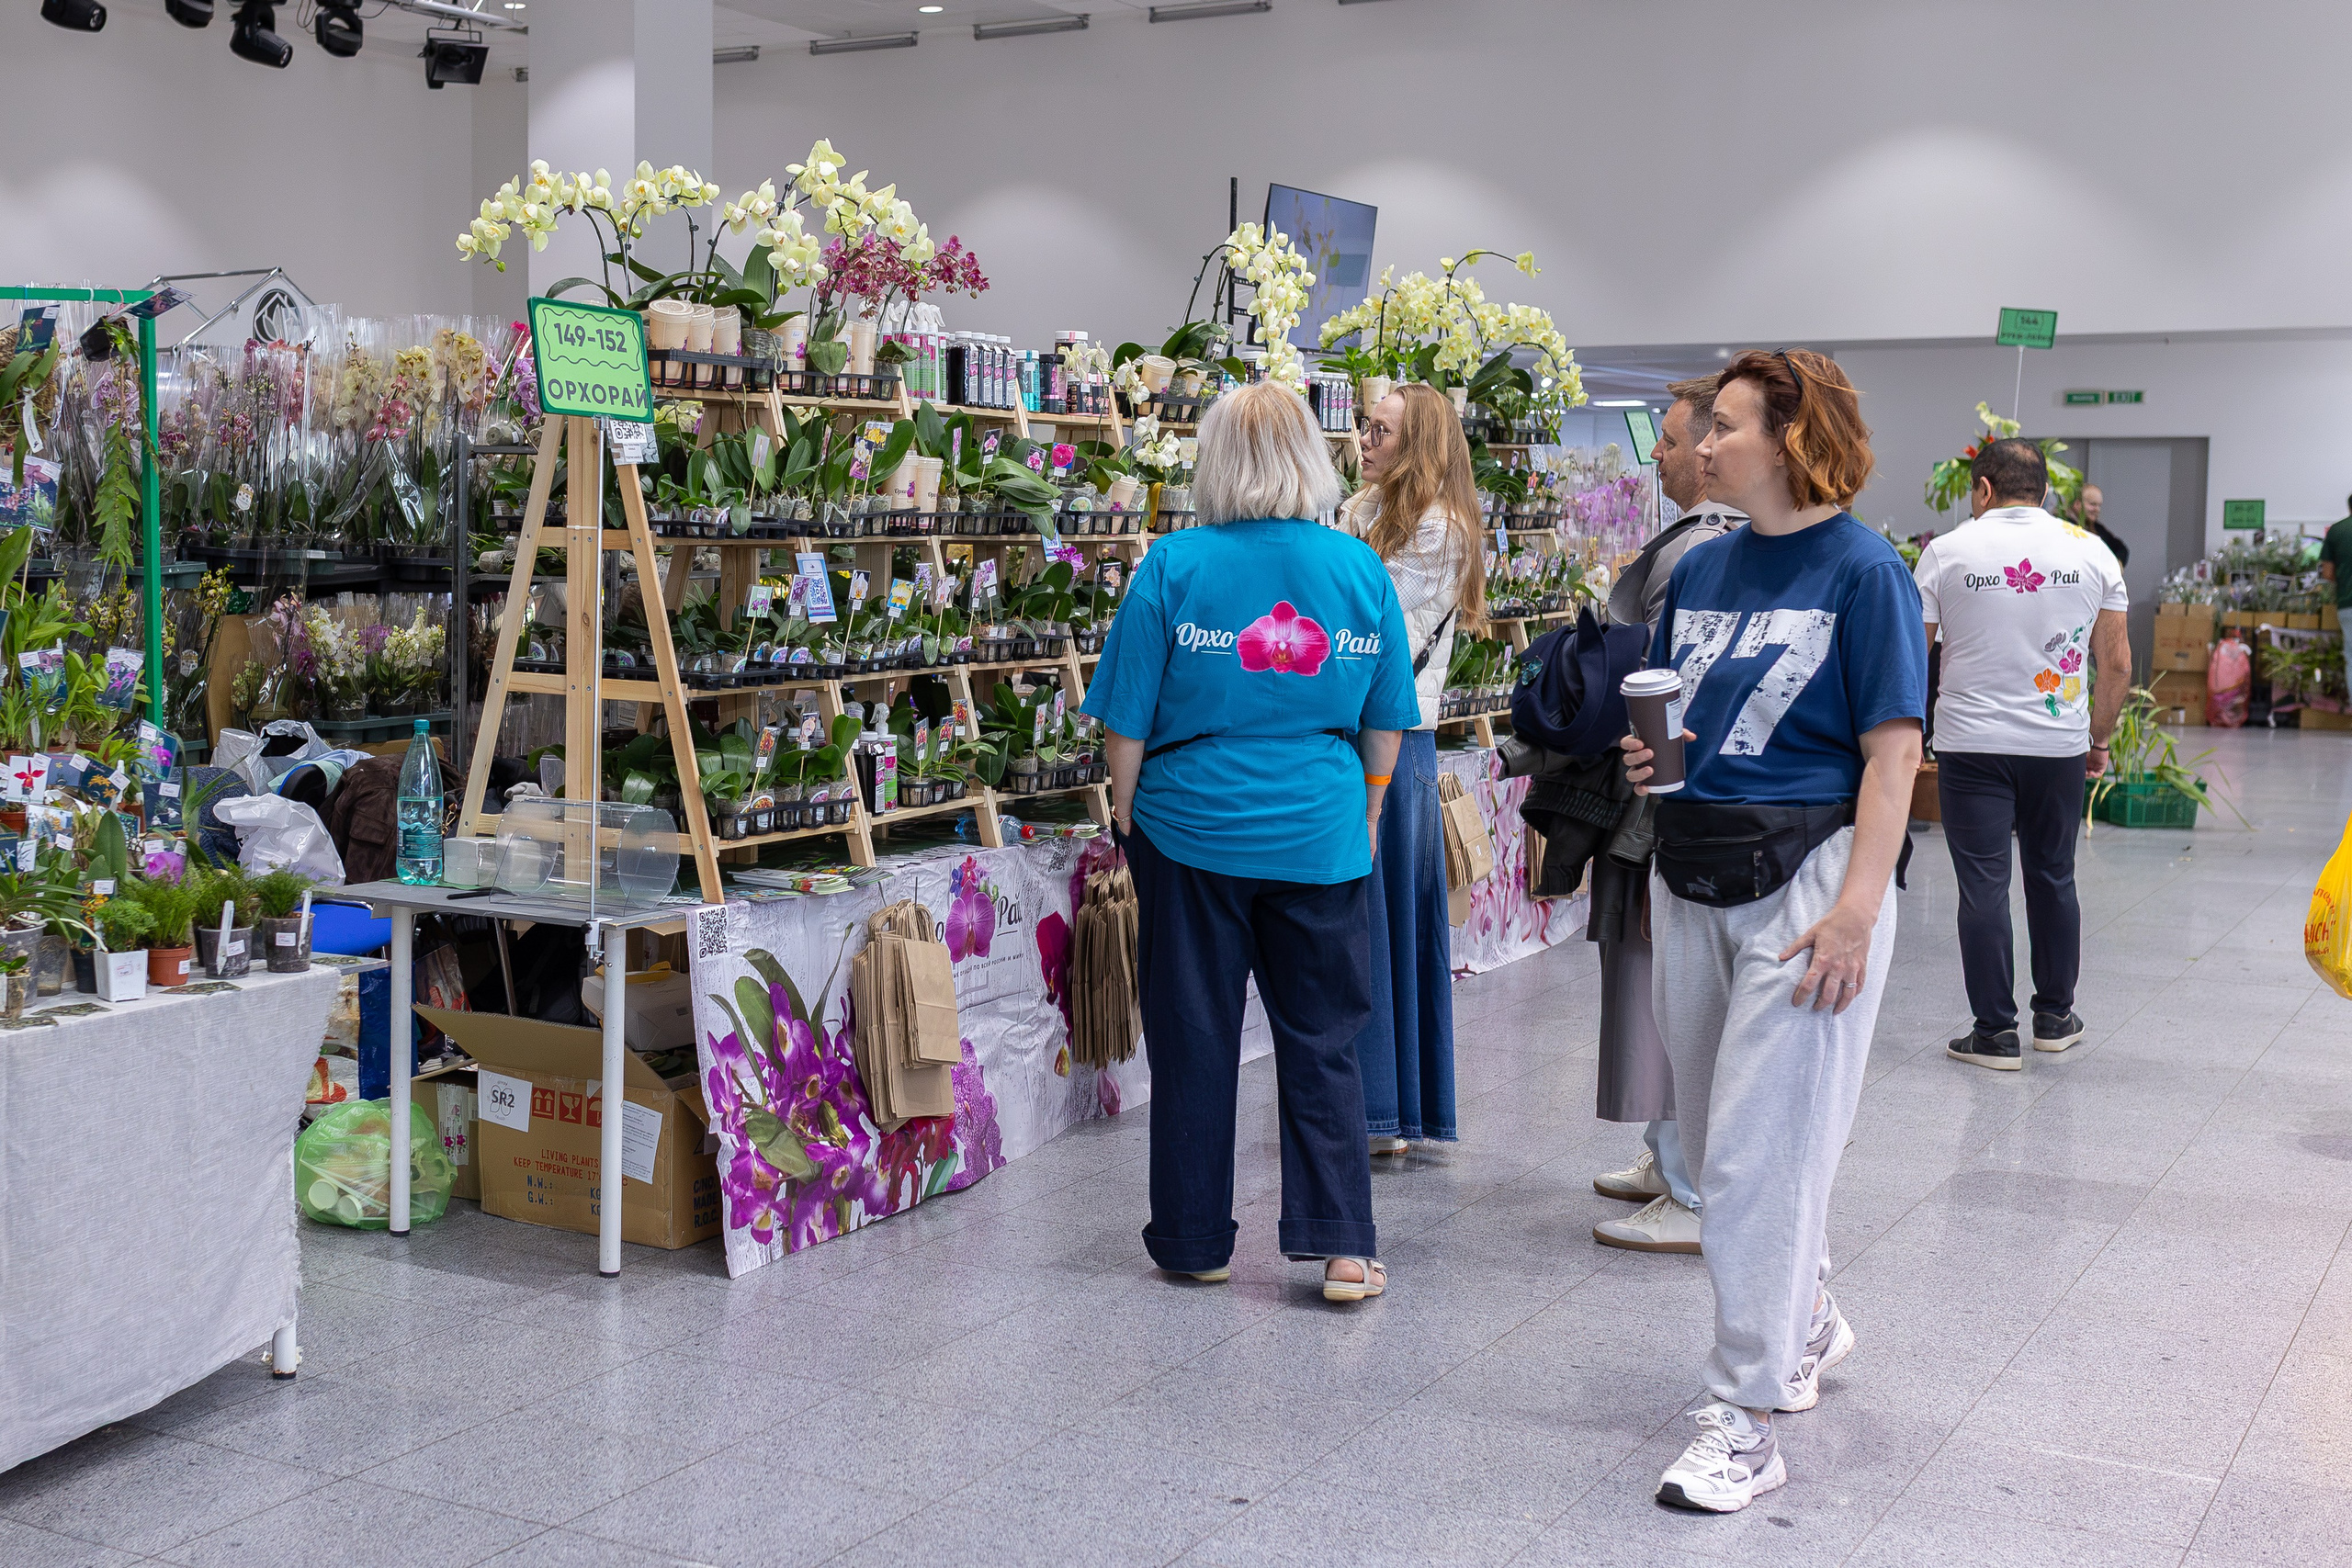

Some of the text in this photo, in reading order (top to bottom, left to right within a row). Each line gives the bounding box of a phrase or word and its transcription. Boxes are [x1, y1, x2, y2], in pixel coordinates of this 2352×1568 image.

[553, 322, 628, 354] 149-152
[548, 378, 649, 410] ОРХОРАЙ
[1963, 570, 2080, 592] Орхо Рай
[1175, 622, 1381, 655] Орхо Рай
[1670, 608, 1838, 756] 77
[491, 1089, 515, 1109] SR2
[514, 1156, 532, 1169] KEEP
[535, 1160, 583, 1179] TEMPERATURE
[541, 1148, 600, 1168] LIVING PLANTS
[526, 1174, 553, 1190] N.W.:
[527, 1190, 553, 1206] G.W.:
